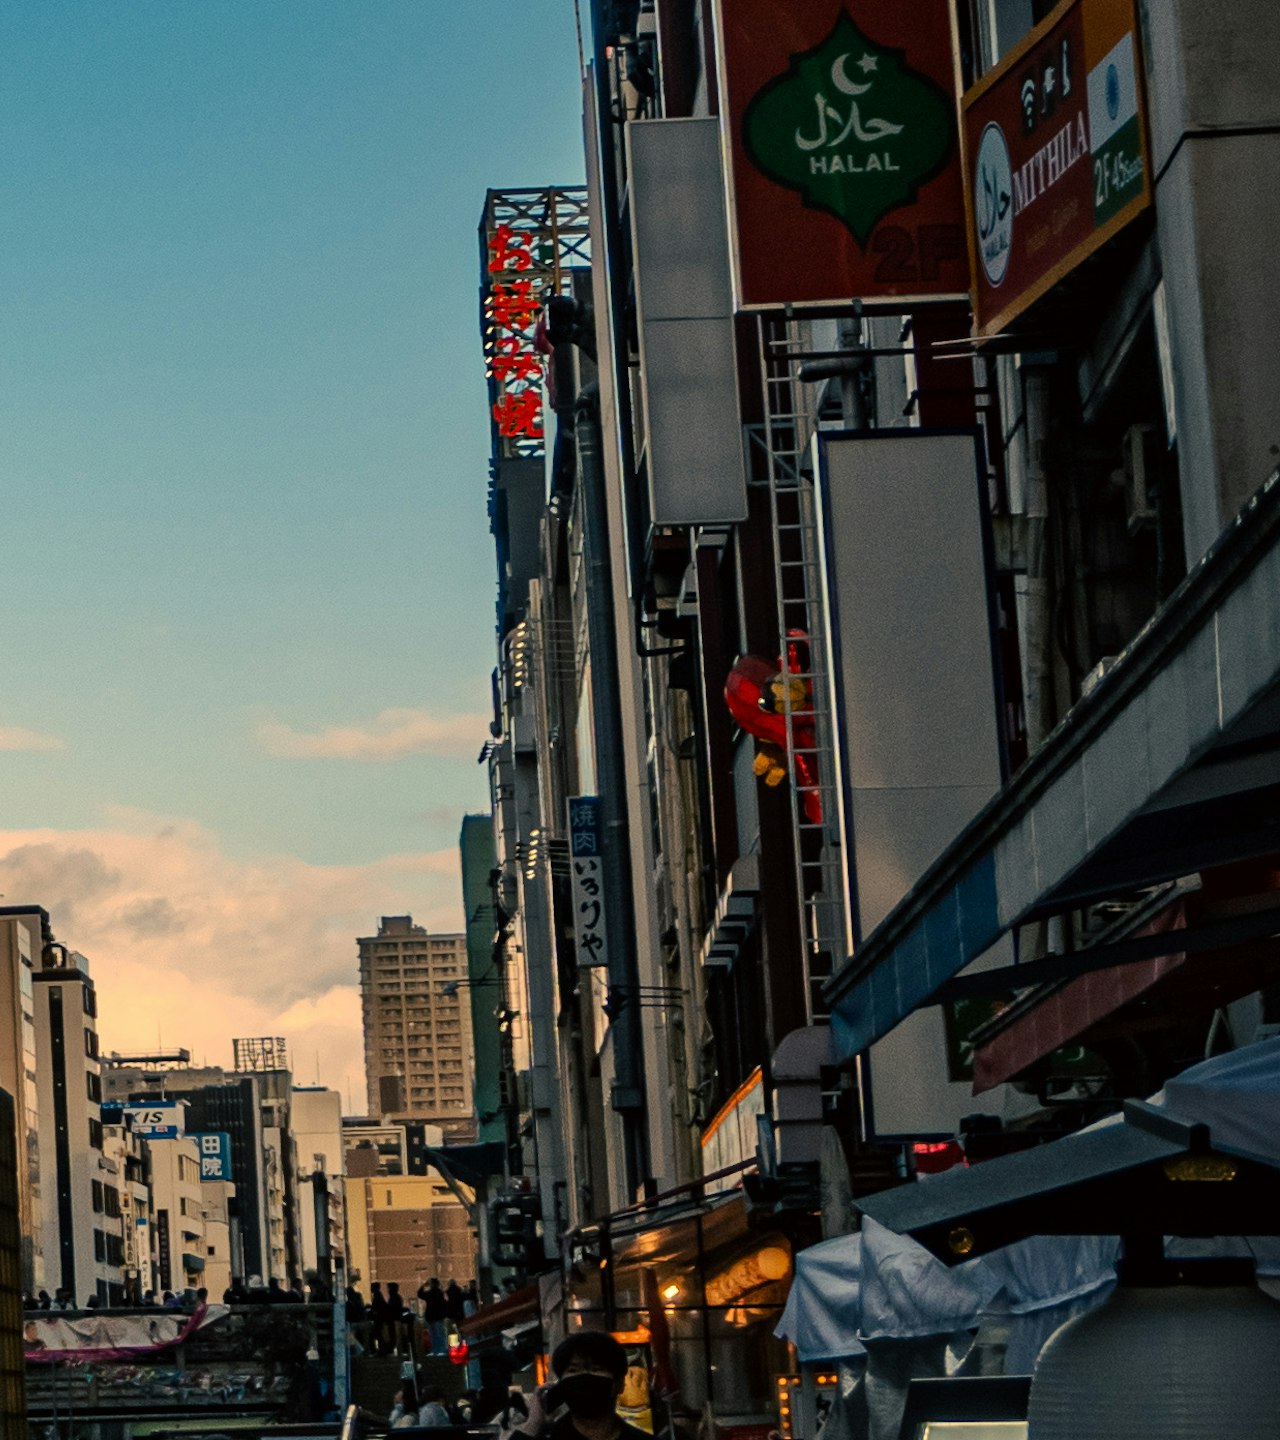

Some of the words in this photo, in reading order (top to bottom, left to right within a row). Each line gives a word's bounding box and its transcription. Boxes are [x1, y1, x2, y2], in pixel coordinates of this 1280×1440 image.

[794, 91, 905, 151] حلال
[809, 151, 901, 175] HALAL
[1012, 110, 1089, 217] MITHILA
[572, 805, 597, 853] 焼肉
[575, 859, 604, 961] いろりや
